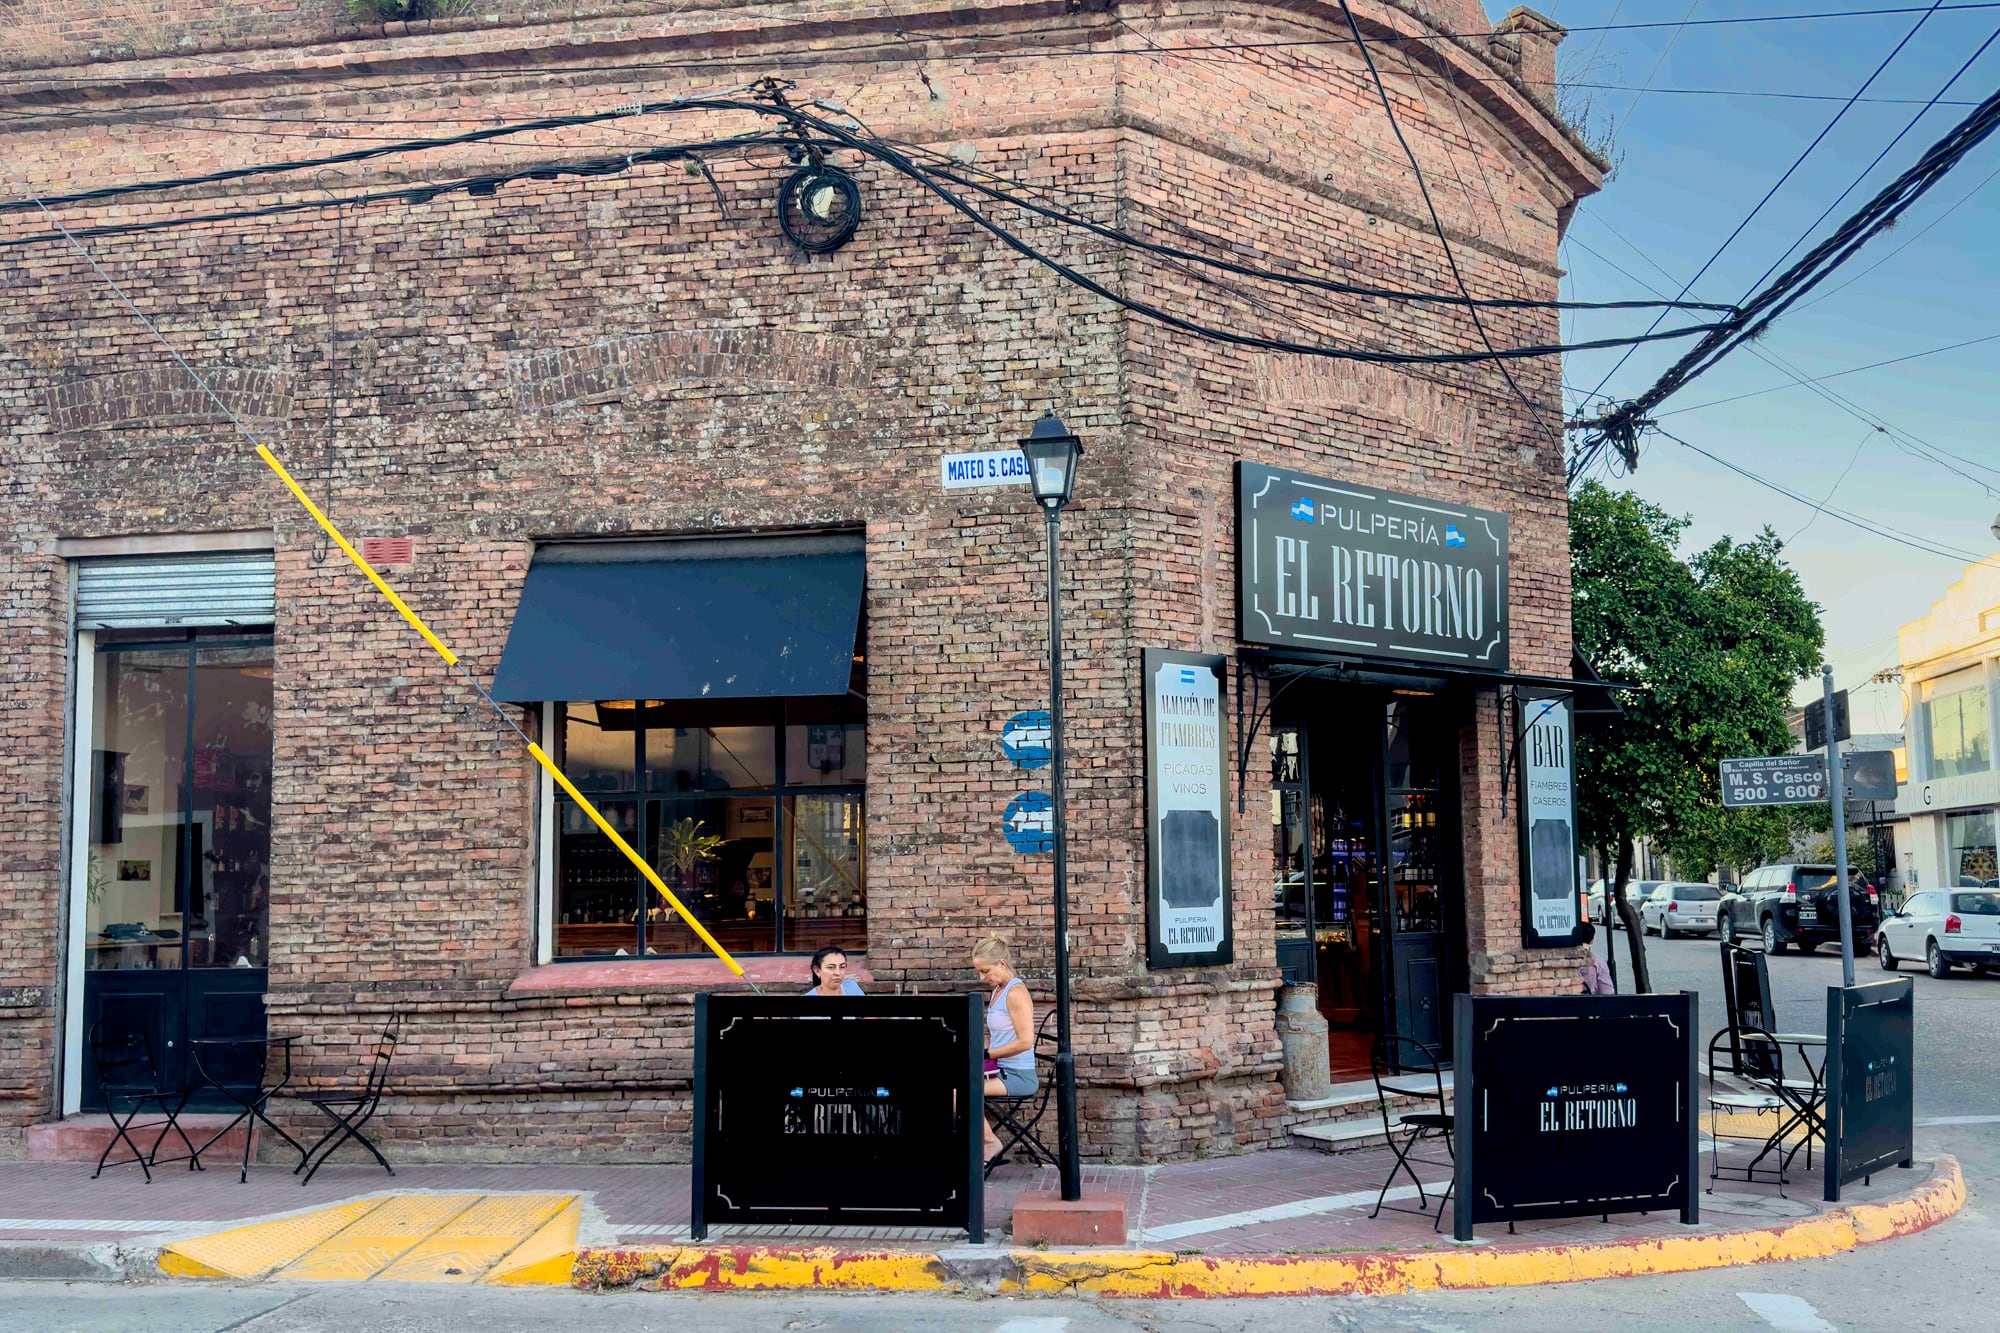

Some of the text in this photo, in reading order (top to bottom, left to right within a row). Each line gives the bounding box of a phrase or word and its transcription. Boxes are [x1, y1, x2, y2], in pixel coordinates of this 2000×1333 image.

[948, 459, 984, 481] MATEO
[989, 458, 999, 477] S.
[1320, 503, 1440, 546] PULPERÍA
[1275, 535, 1484, 641] EL RETORNO
[1160, 692, 1215, 717] ALMACÉN DE
[1160, 721, 1216, 749] FIAMBRES
[1532, 724, 1565, 768] BAR
[1164, 763, 1214, 776] PICADAS
[1739, 760, 1764, 768] Capilla
[1530, 780, 1568, 791] FIAMBRES
[1729, 771, 1823, 786] M. S. Casco
[1172, 783, 1207, 795] VINOS
[1734, 787, 1768, 801] 500
[1784, 784, 1819, 798] 600
[1533, 796, 1567, 807] CASEROS
[1168, 926, 1215, 945] EL RETORNO
[1540, 1098, 1636, 1132] EL RETORNO
